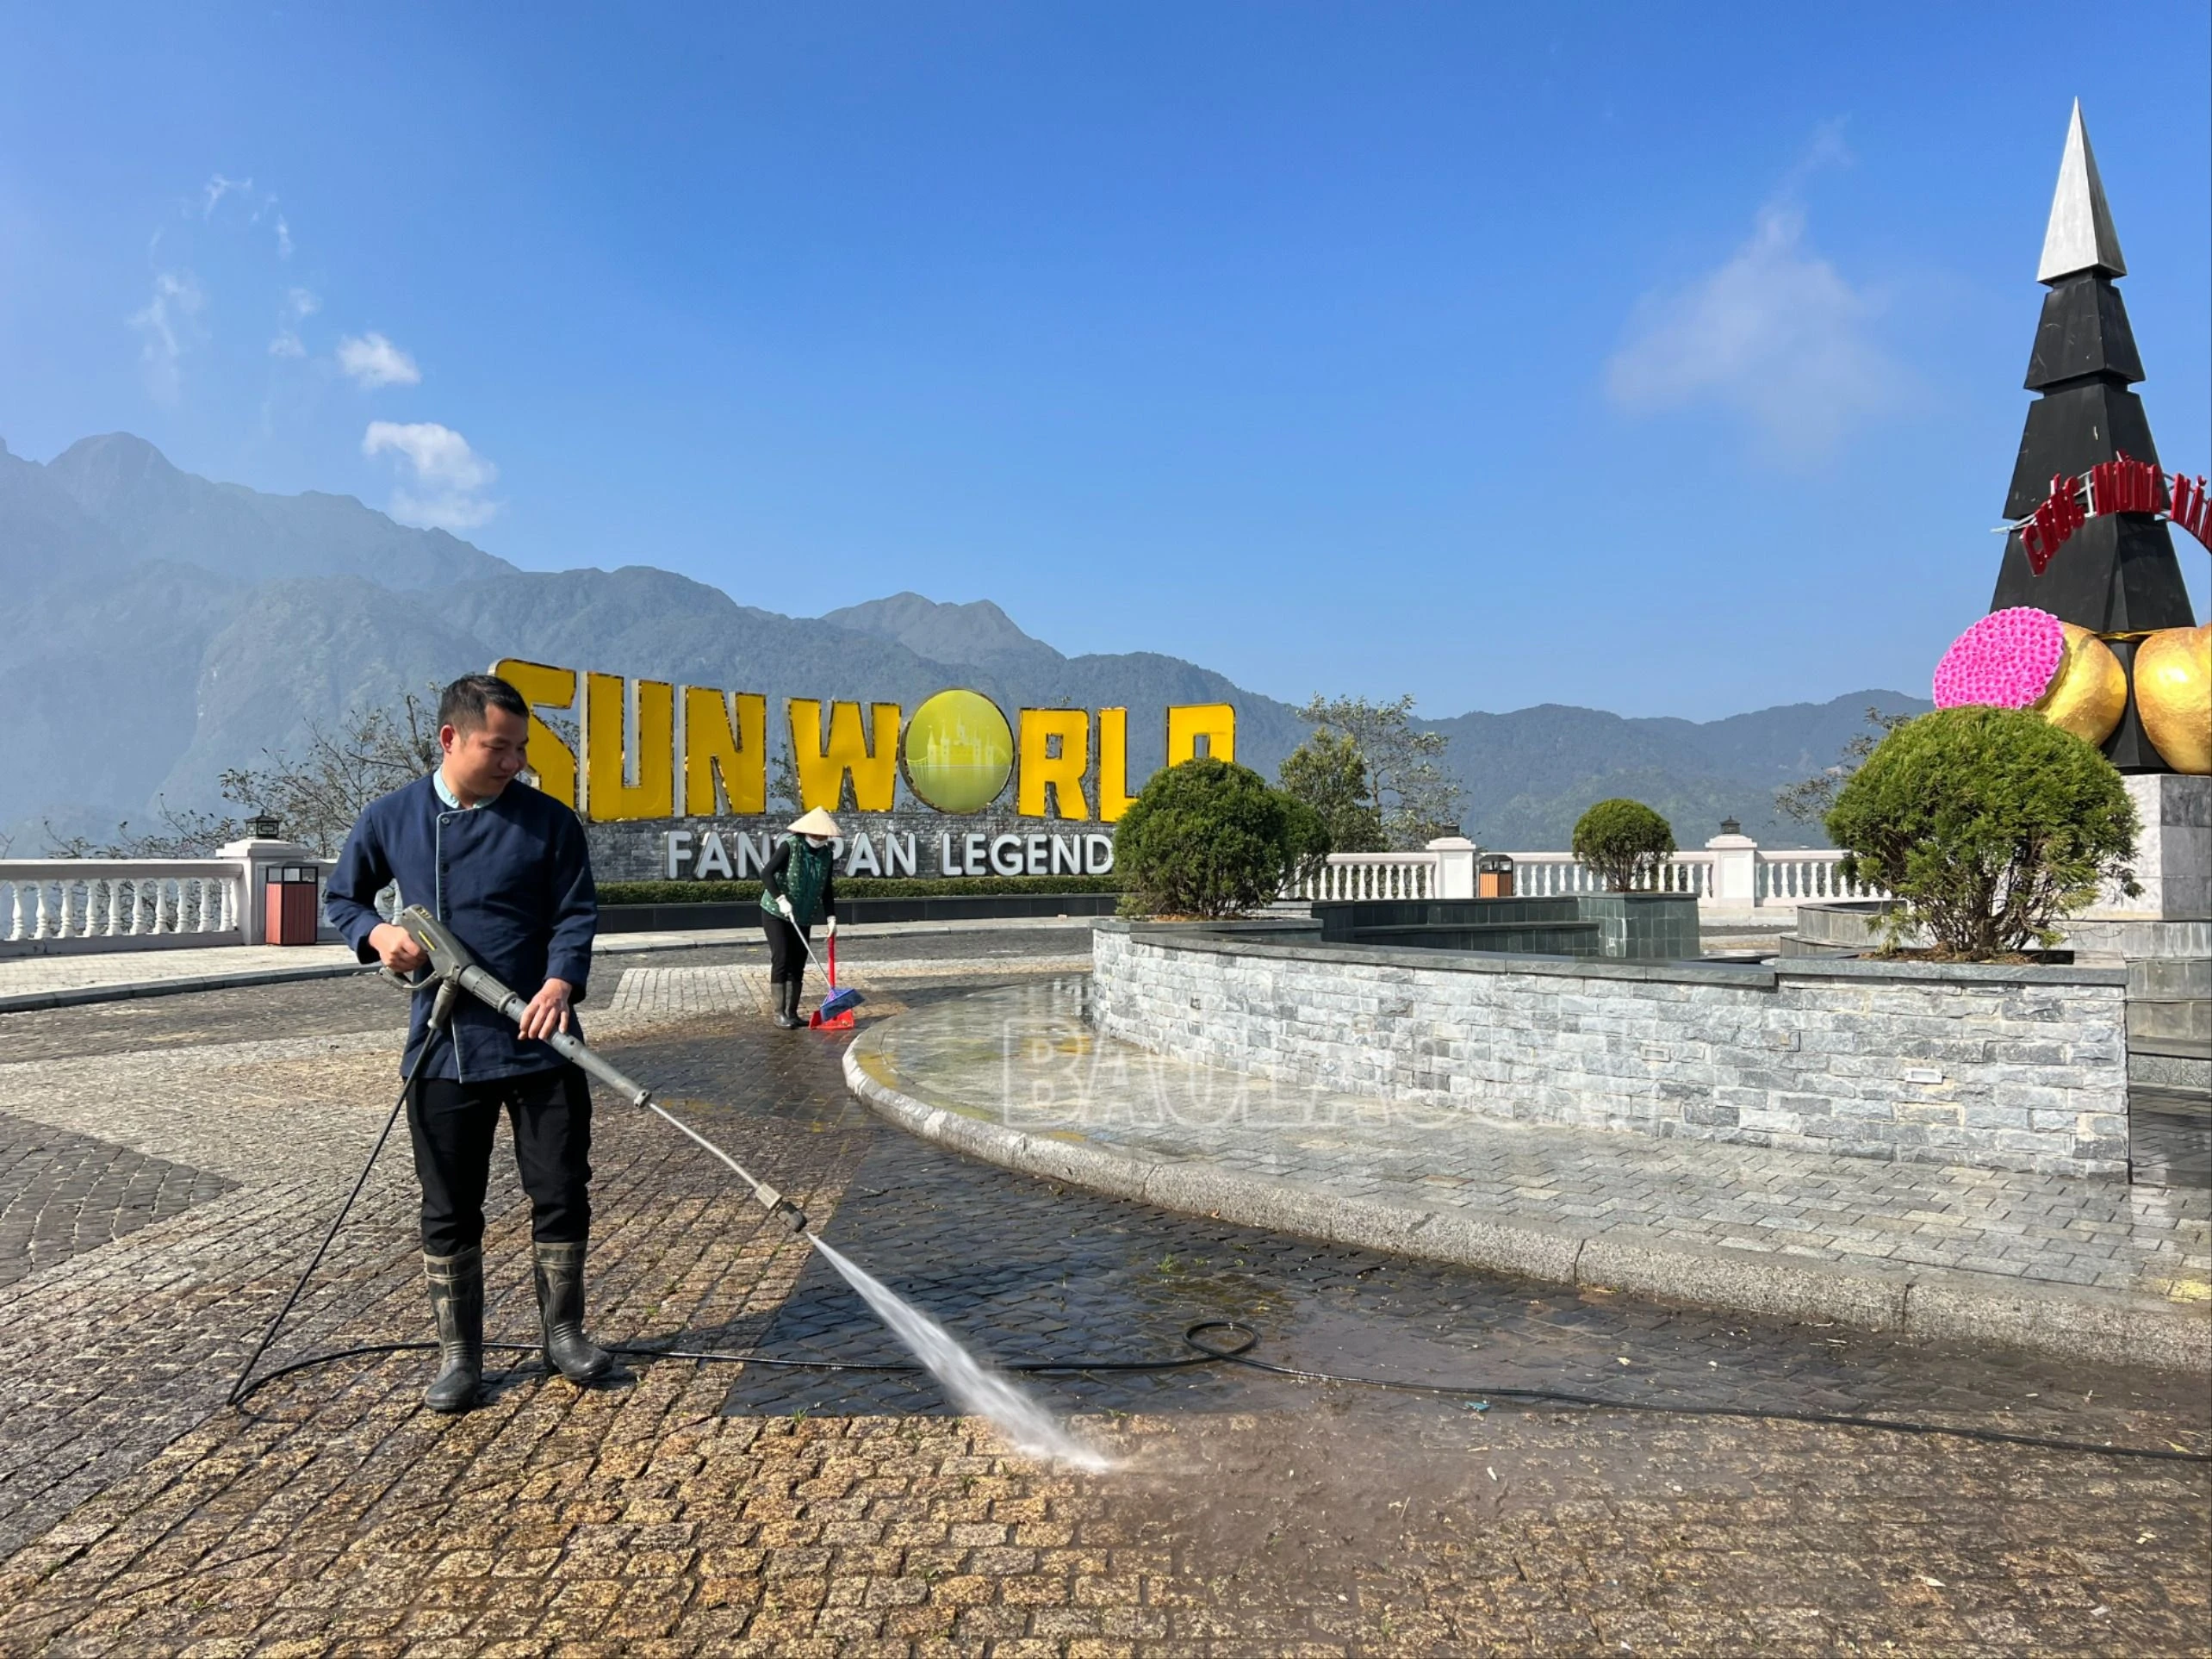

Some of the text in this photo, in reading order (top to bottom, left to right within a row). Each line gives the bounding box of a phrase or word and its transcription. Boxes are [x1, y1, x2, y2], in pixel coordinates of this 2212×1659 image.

[488, 657, 767, 824] SUN
[666, 830, 1115, 879] FANAN LEGEND
